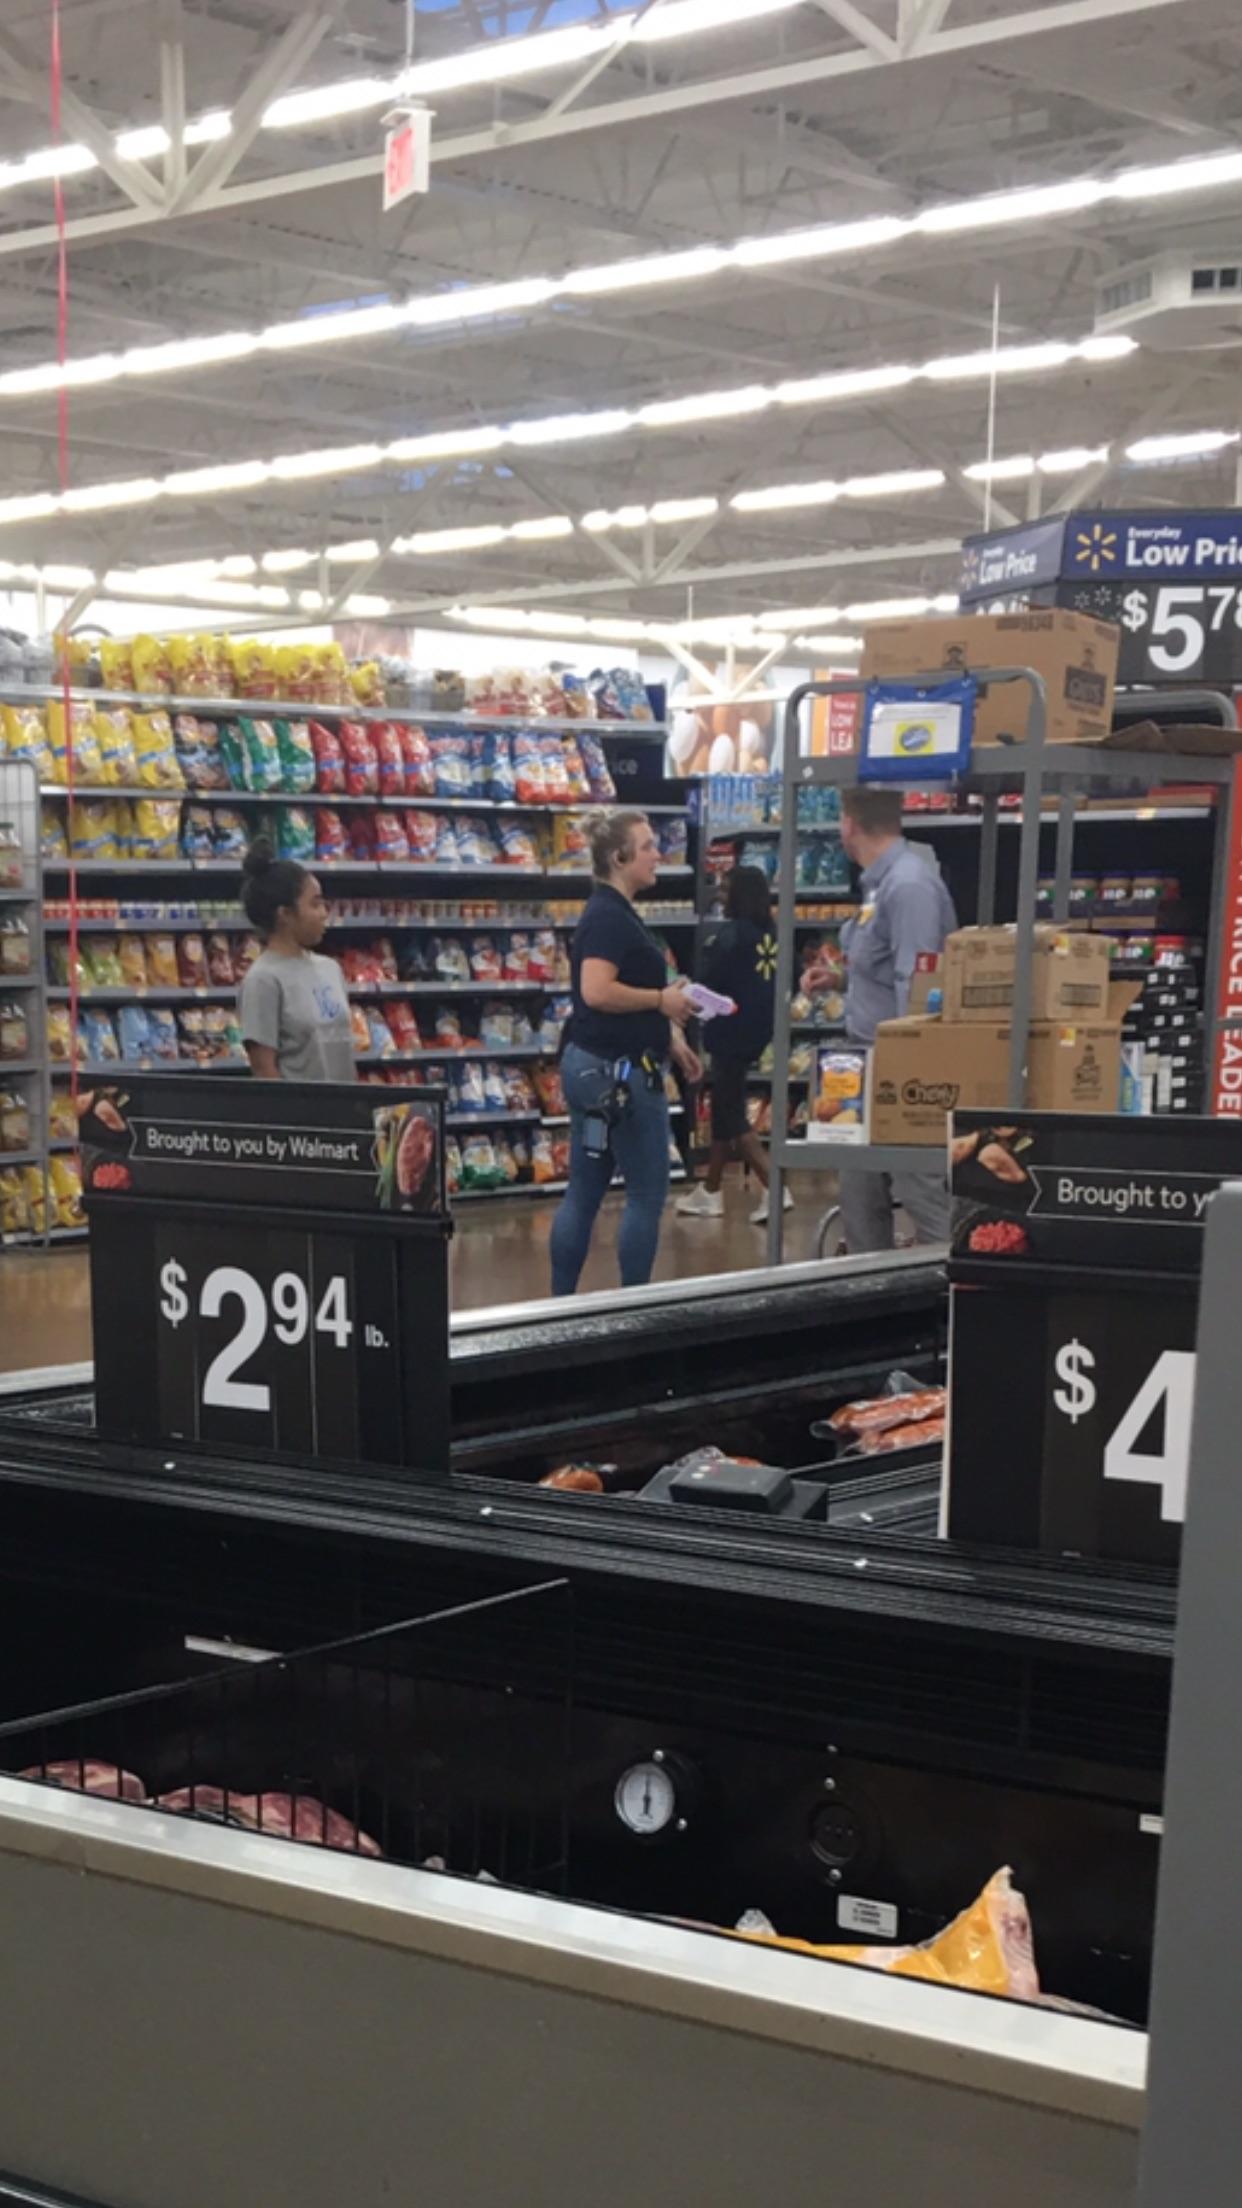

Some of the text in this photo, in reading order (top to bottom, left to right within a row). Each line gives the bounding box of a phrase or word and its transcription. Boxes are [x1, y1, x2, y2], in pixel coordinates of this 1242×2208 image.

[1128, 526, 1182, 541] Everyday
[1126, 539, 1190, 567] Low
[901, 1078, 960, 1110] Chewy
[146, 1128, 360, 1161] Brought to you by Walmart
[1057, 1178, 1154, 1213] Brought
[1159, 1186, 1187, 1210] to
[365, 1324, 390, 1348] lb.
